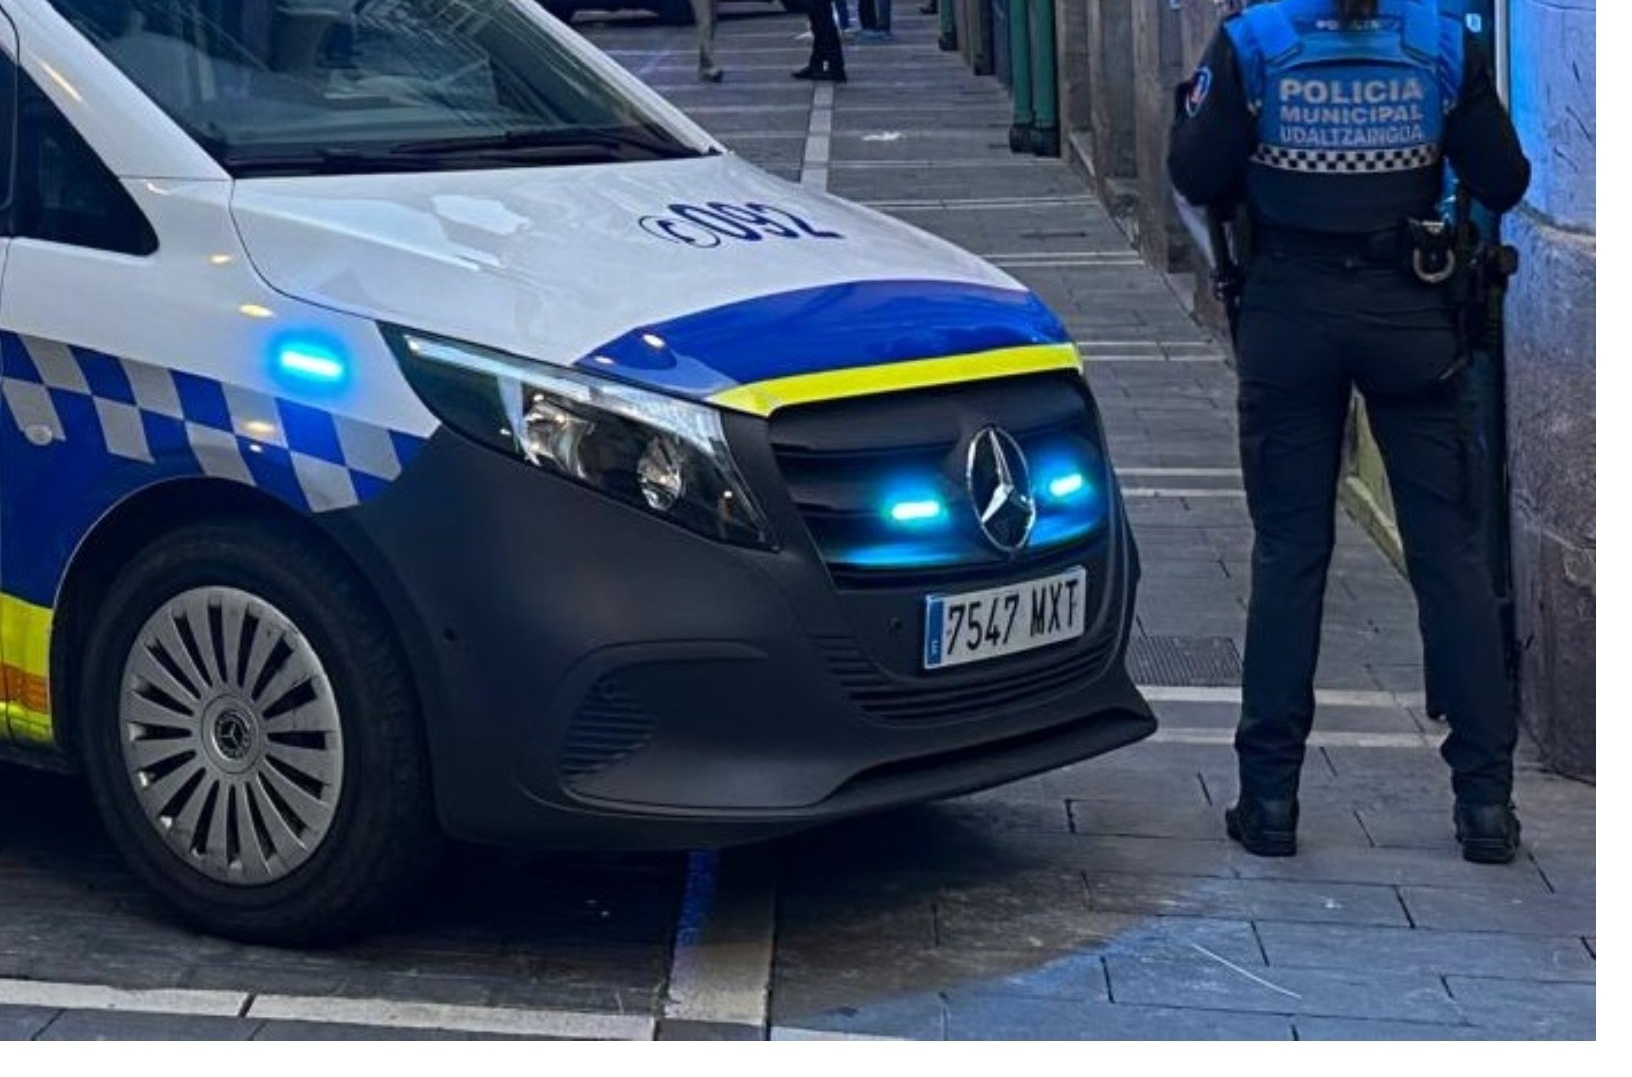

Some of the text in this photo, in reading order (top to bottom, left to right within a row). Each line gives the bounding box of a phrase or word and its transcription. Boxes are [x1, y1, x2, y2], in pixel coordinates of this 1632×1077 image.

[1279, 78, 1424, 104] POLICIA
[1280, 104, 1425, 124] MUNICIPAL
[1279, 124, 1425, 146] UDALTZAINGOA
[668, 201, 847, 242] 092
[947, 578, 1079, 655] 7547 MXT
